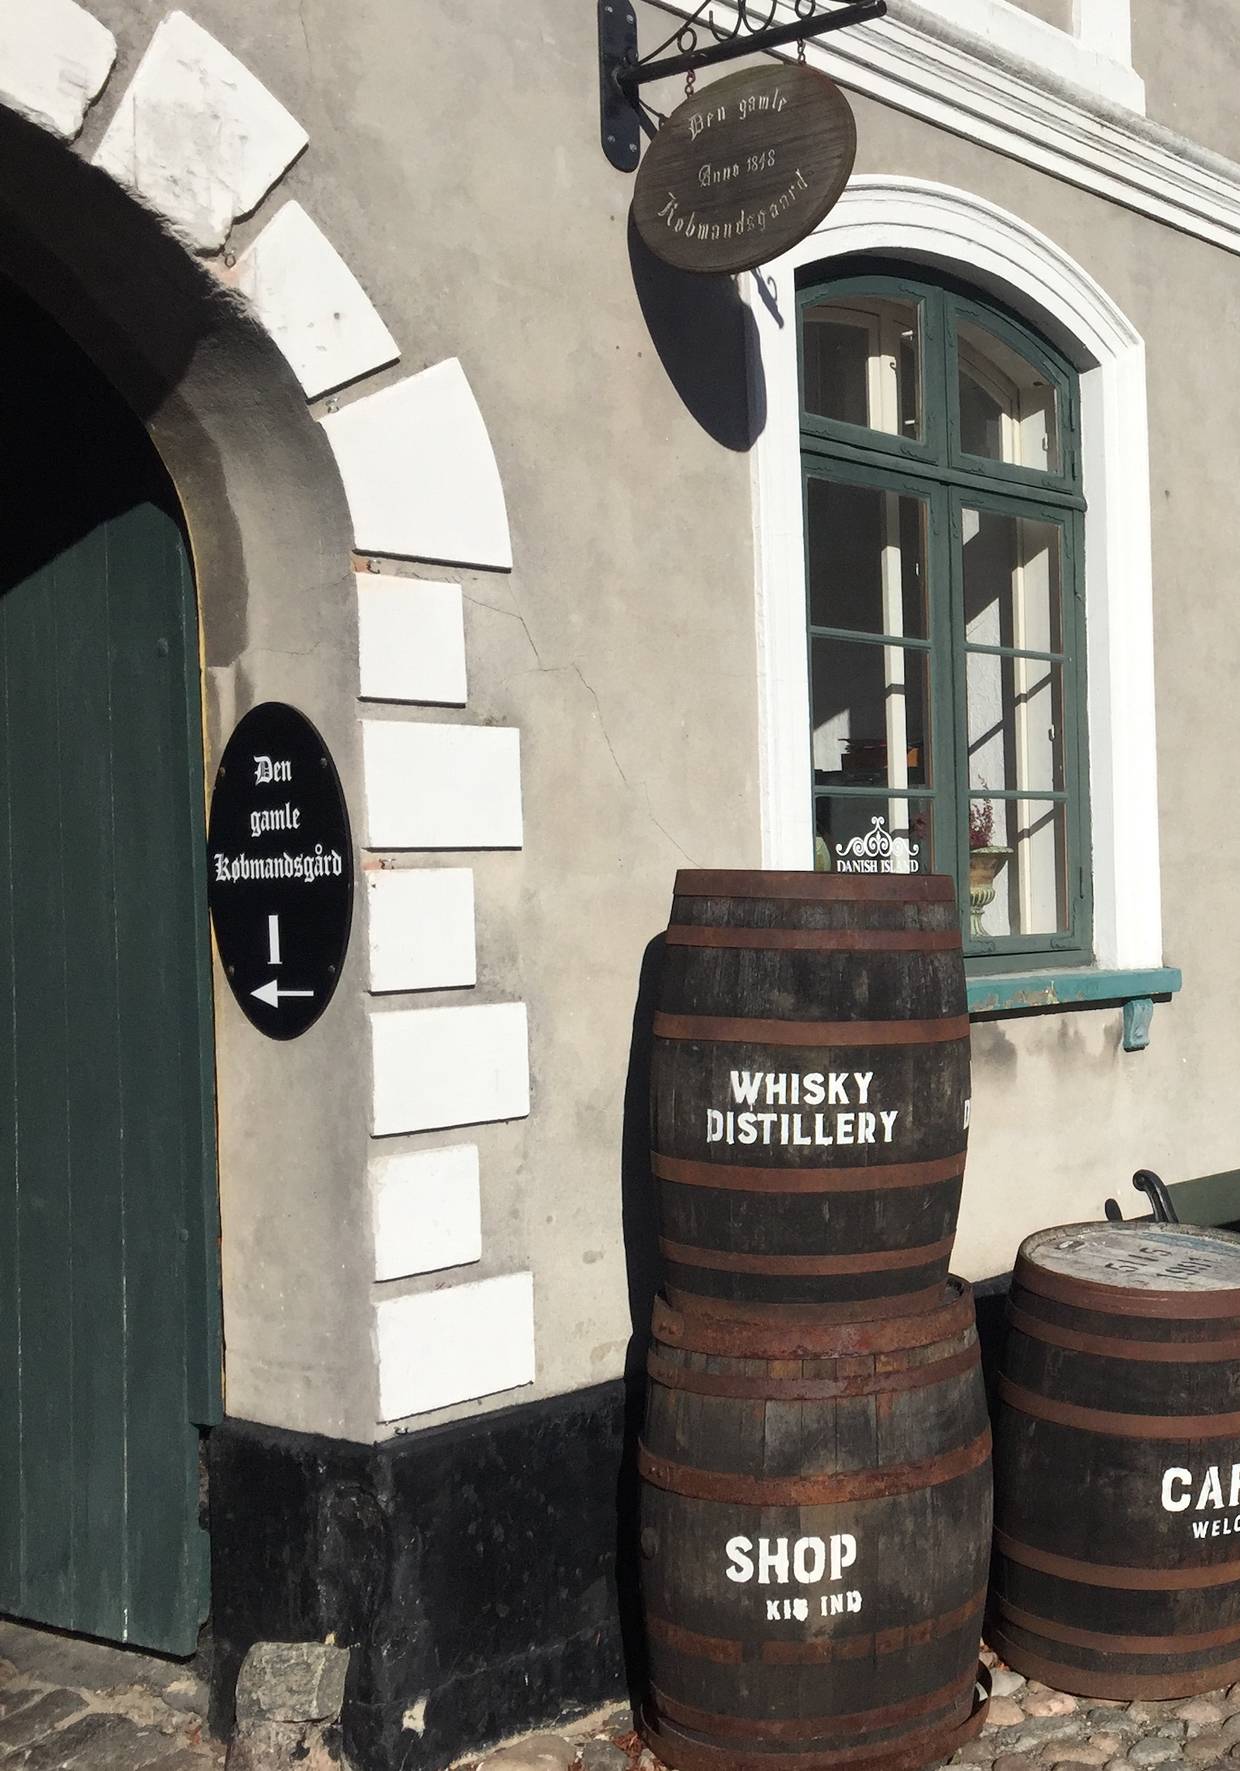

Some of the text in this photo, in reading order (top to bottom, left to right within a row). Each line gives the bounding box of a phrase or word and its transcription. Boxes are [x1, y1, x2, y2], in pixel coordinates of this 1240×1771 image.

[688, 87, 788, 141] Den gamle
[698, 162, 740, 188] Anno
[253, 755, 292, 784] Den
[250, 802, 300, 838] gamle
[836, 859, 919, 873] DANISH ISLD
[730, 1070, 874, 1107] WHISKY
[706, 1108, 898, 1146] DISTILLERY
[725, 1533, 857, 1585] SHOP
[820, 1590, 863, 1617] IND
